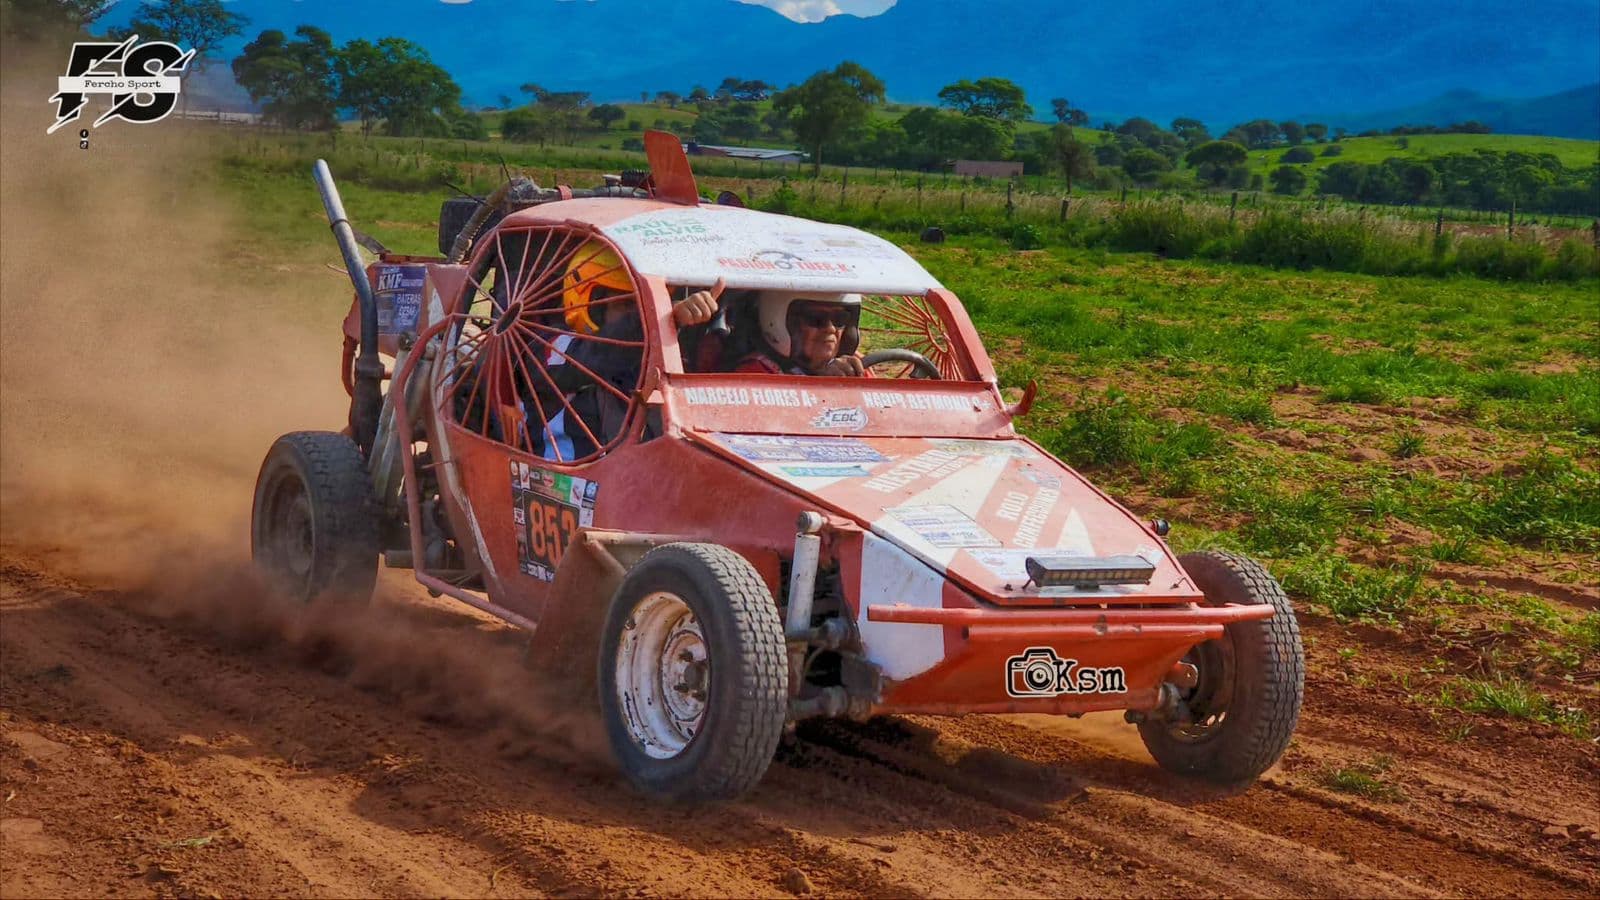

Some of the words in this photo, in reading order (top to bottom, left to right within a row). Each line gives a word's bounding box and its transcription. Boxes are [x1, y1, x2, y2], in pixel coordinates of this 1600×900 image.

[643, 225, 706, 237] ALVIS
[684, 387, 750, 405] MARCELO
[752, 388, 801, 407] FLORES
[906, 393, 970, 411] REYMOND
